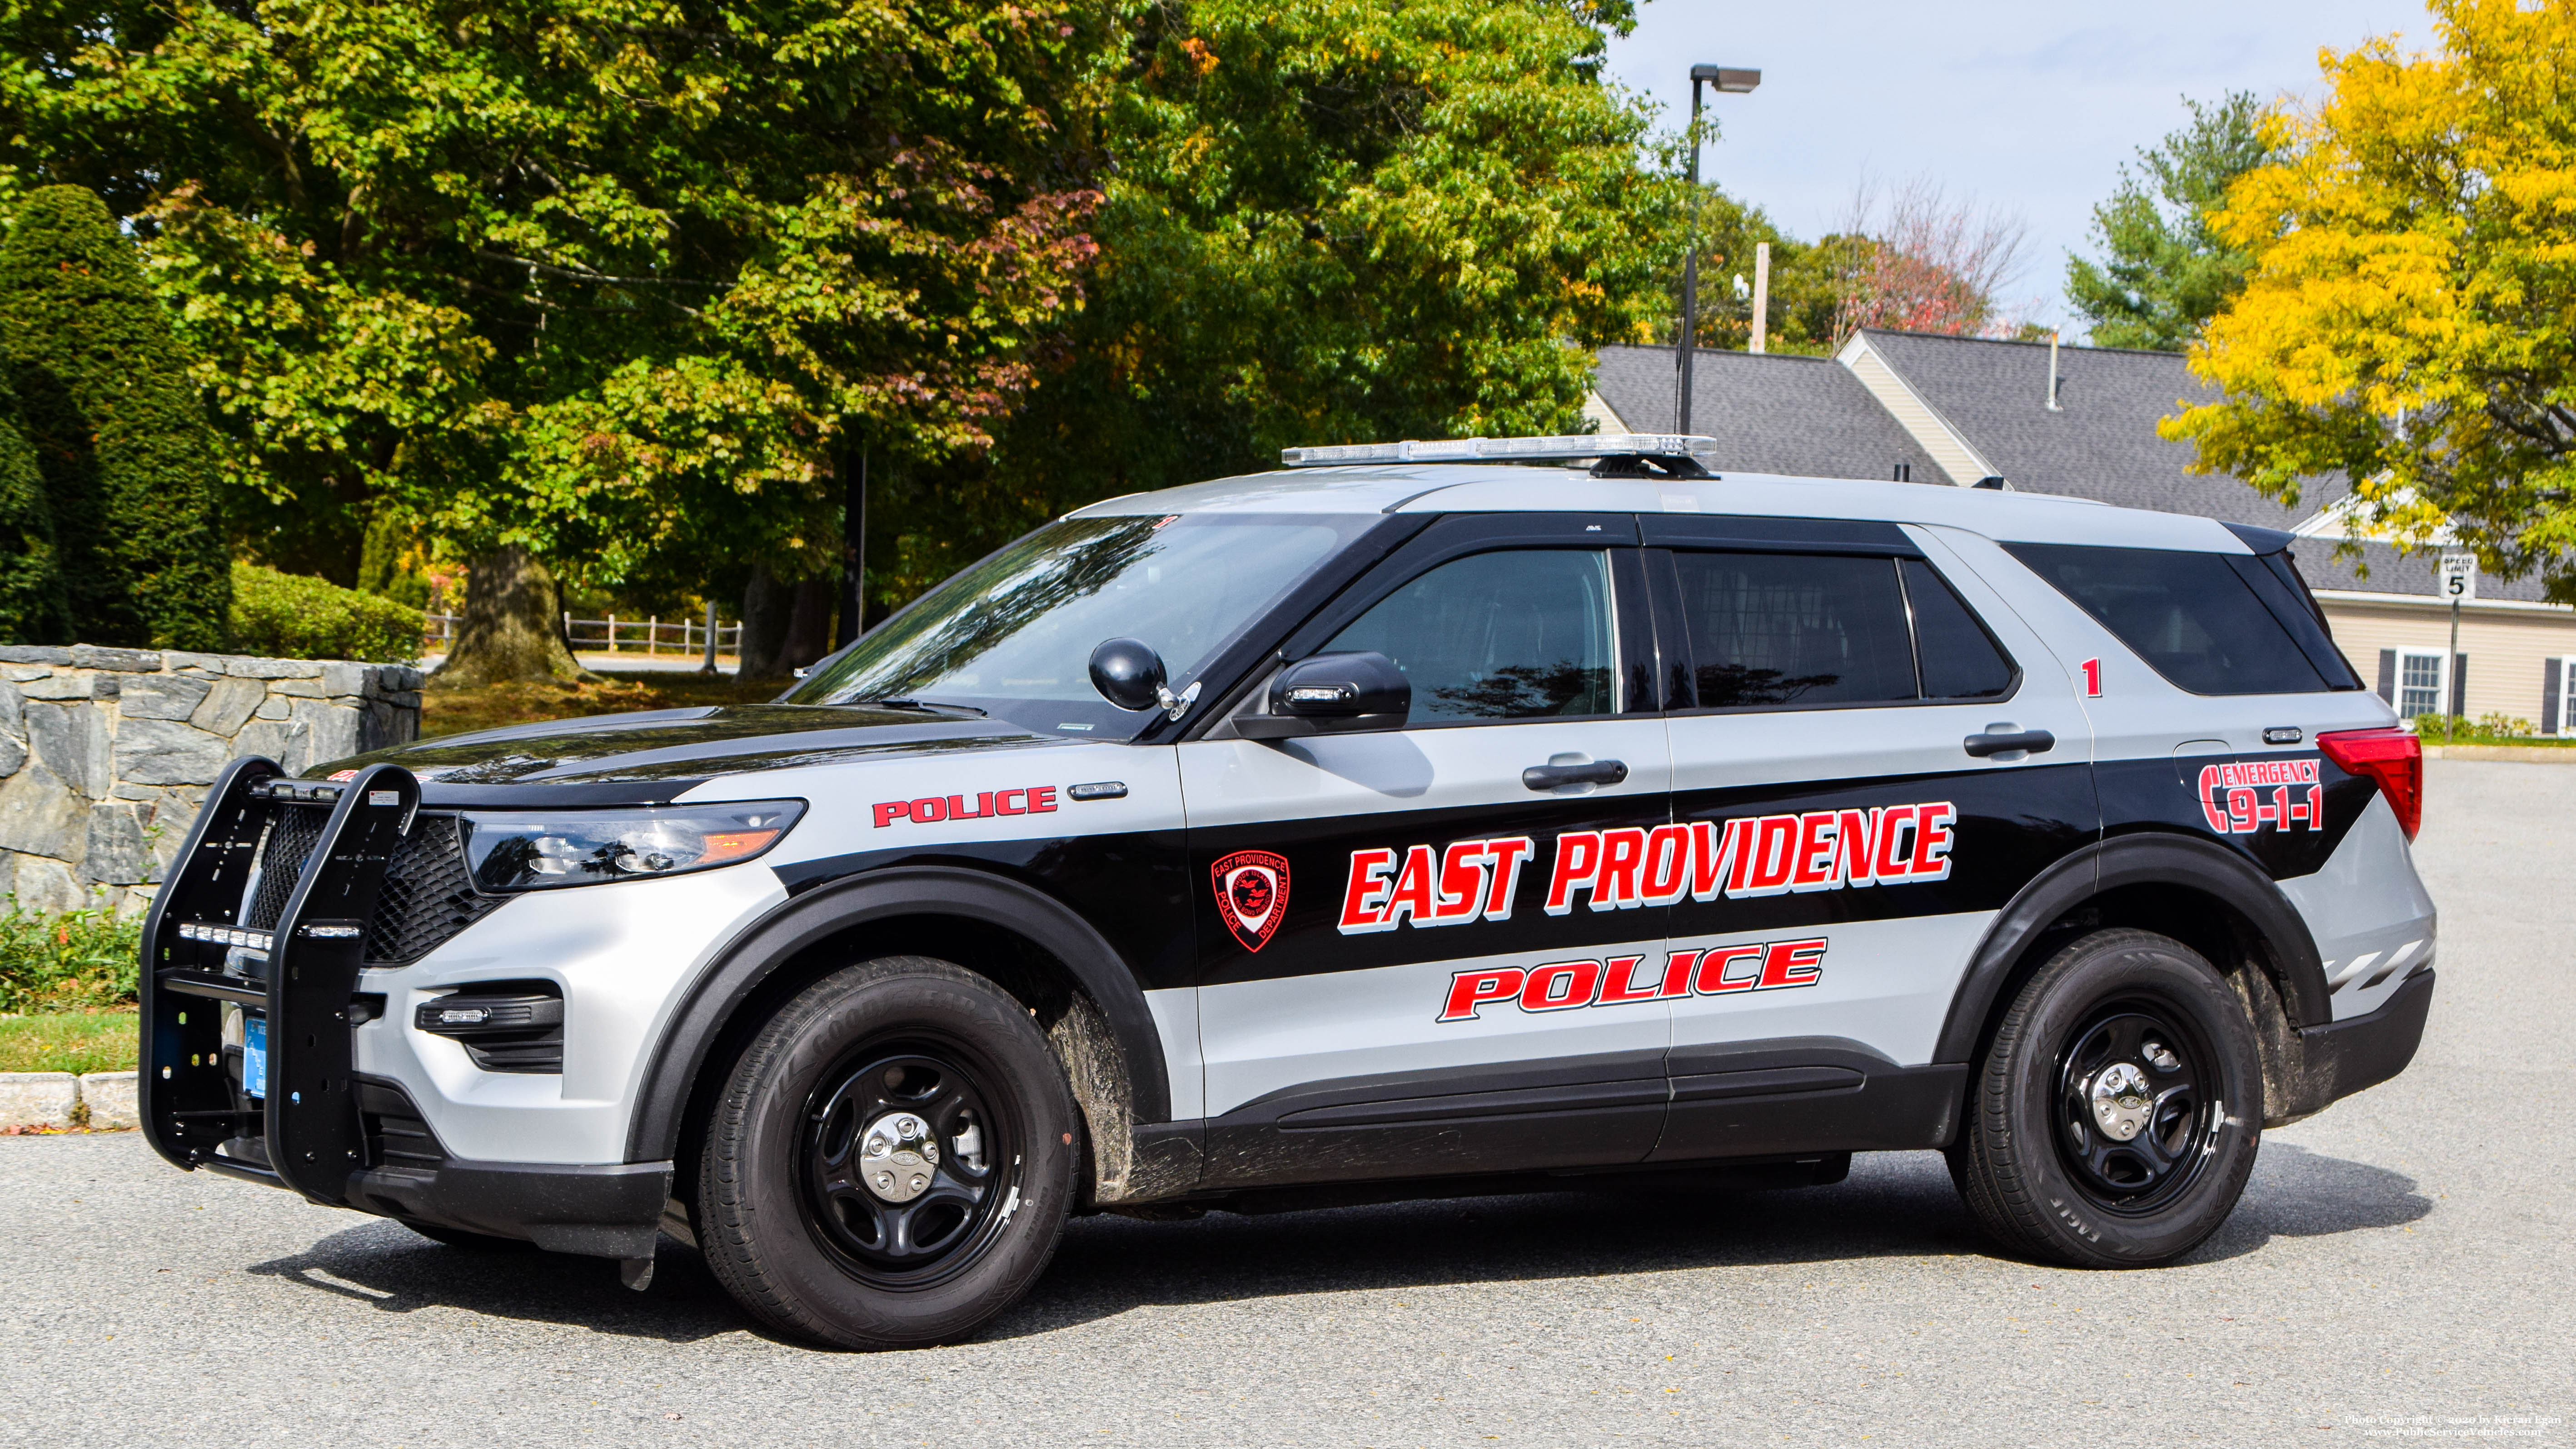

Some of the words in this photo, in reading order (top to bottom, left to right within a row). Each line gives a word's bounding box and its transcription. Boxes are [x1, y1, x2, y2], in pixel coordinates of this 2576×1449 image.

[2448, 574, 2465, 595] 5
[2081, 657, 2103, 698] 1
[2219, 758, 2321, 789] EMERGENCY
[872, 786, 1058, 828] POLICE
[2227, 784, 2322, 834] 9-1-1
[1215, 859, 1232, 878] EAST
[1235, 854, 1285, 872] PROVIDENCE
[1234, 871, 1249, 890] RHODE
[1251, 871, 1270, 887] ISLAND
[1338, 836, 1534, 935] EAST
[1545, 801, 1956, 916] PROVIDENCE
[1218, 891, 1241, 931] POLICE
[1241, 907, 1255, 915] BONO
[1256, 894, 1271, 914] PUBLICO
[1258, 874, 1287, 939] DEPARTMENT
[1435, 937, 1828, 1023] POLICE
